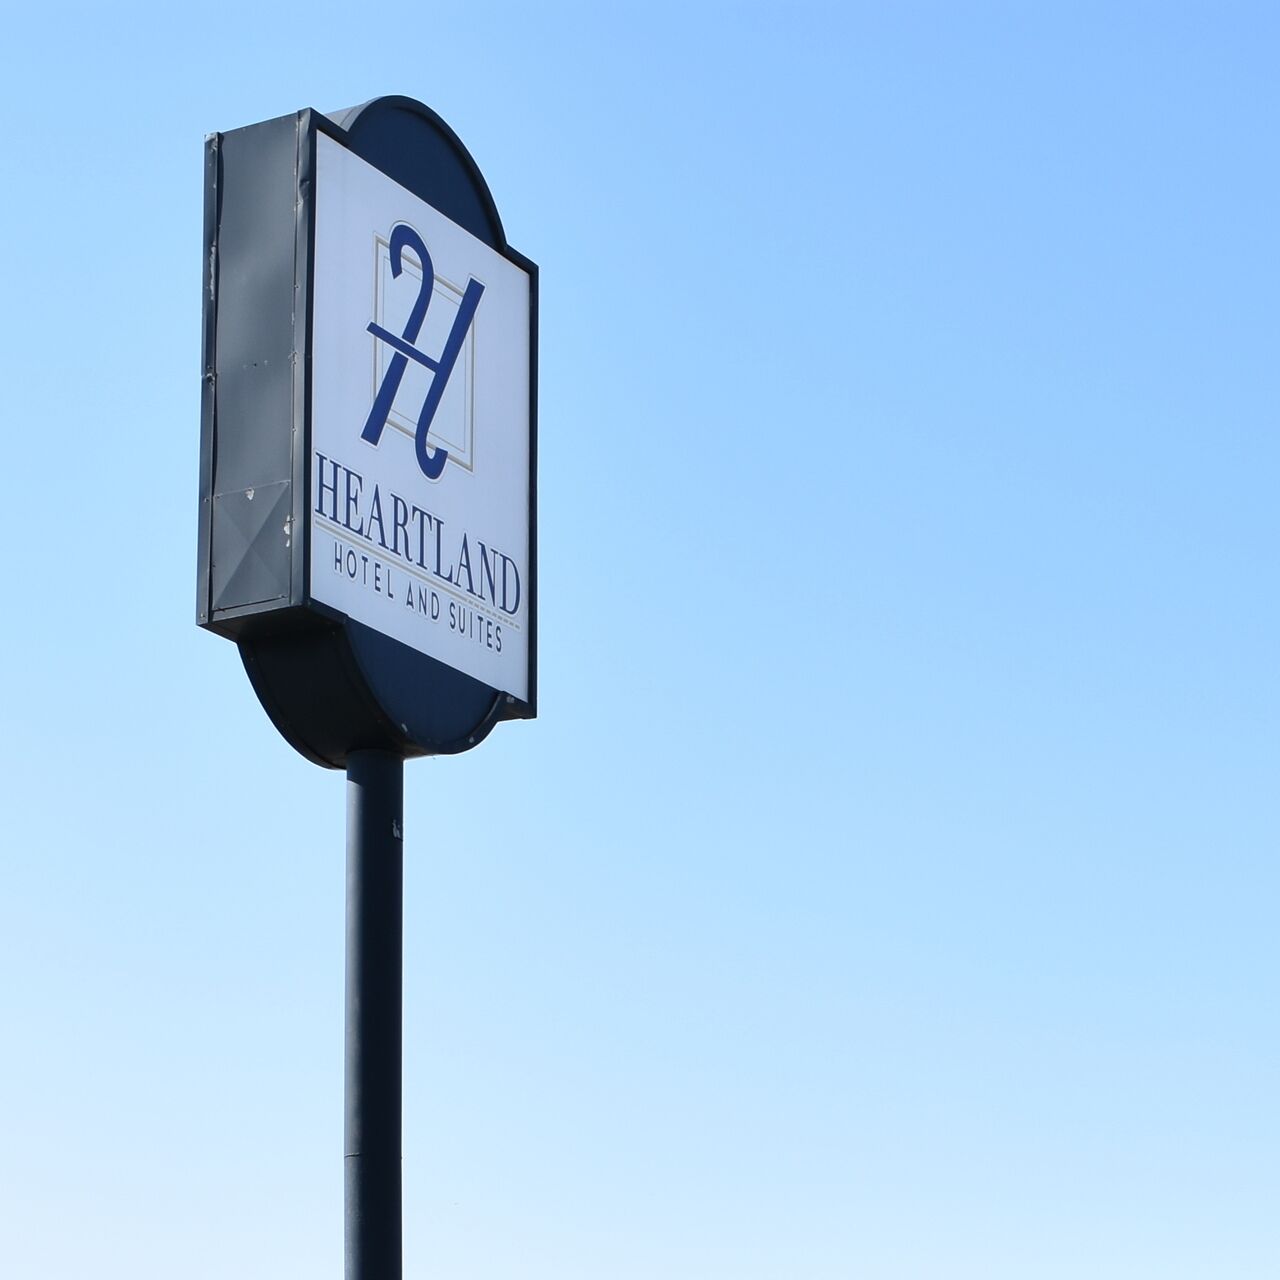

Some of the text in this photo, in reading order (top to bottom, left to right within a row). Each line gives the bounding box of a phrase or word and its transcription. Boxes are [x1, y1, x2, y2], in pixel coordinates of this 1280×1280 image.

[314, 451, 521, 615] HEARTLAND
[334, 541, 502, 652] HOTEL AND SUITES
